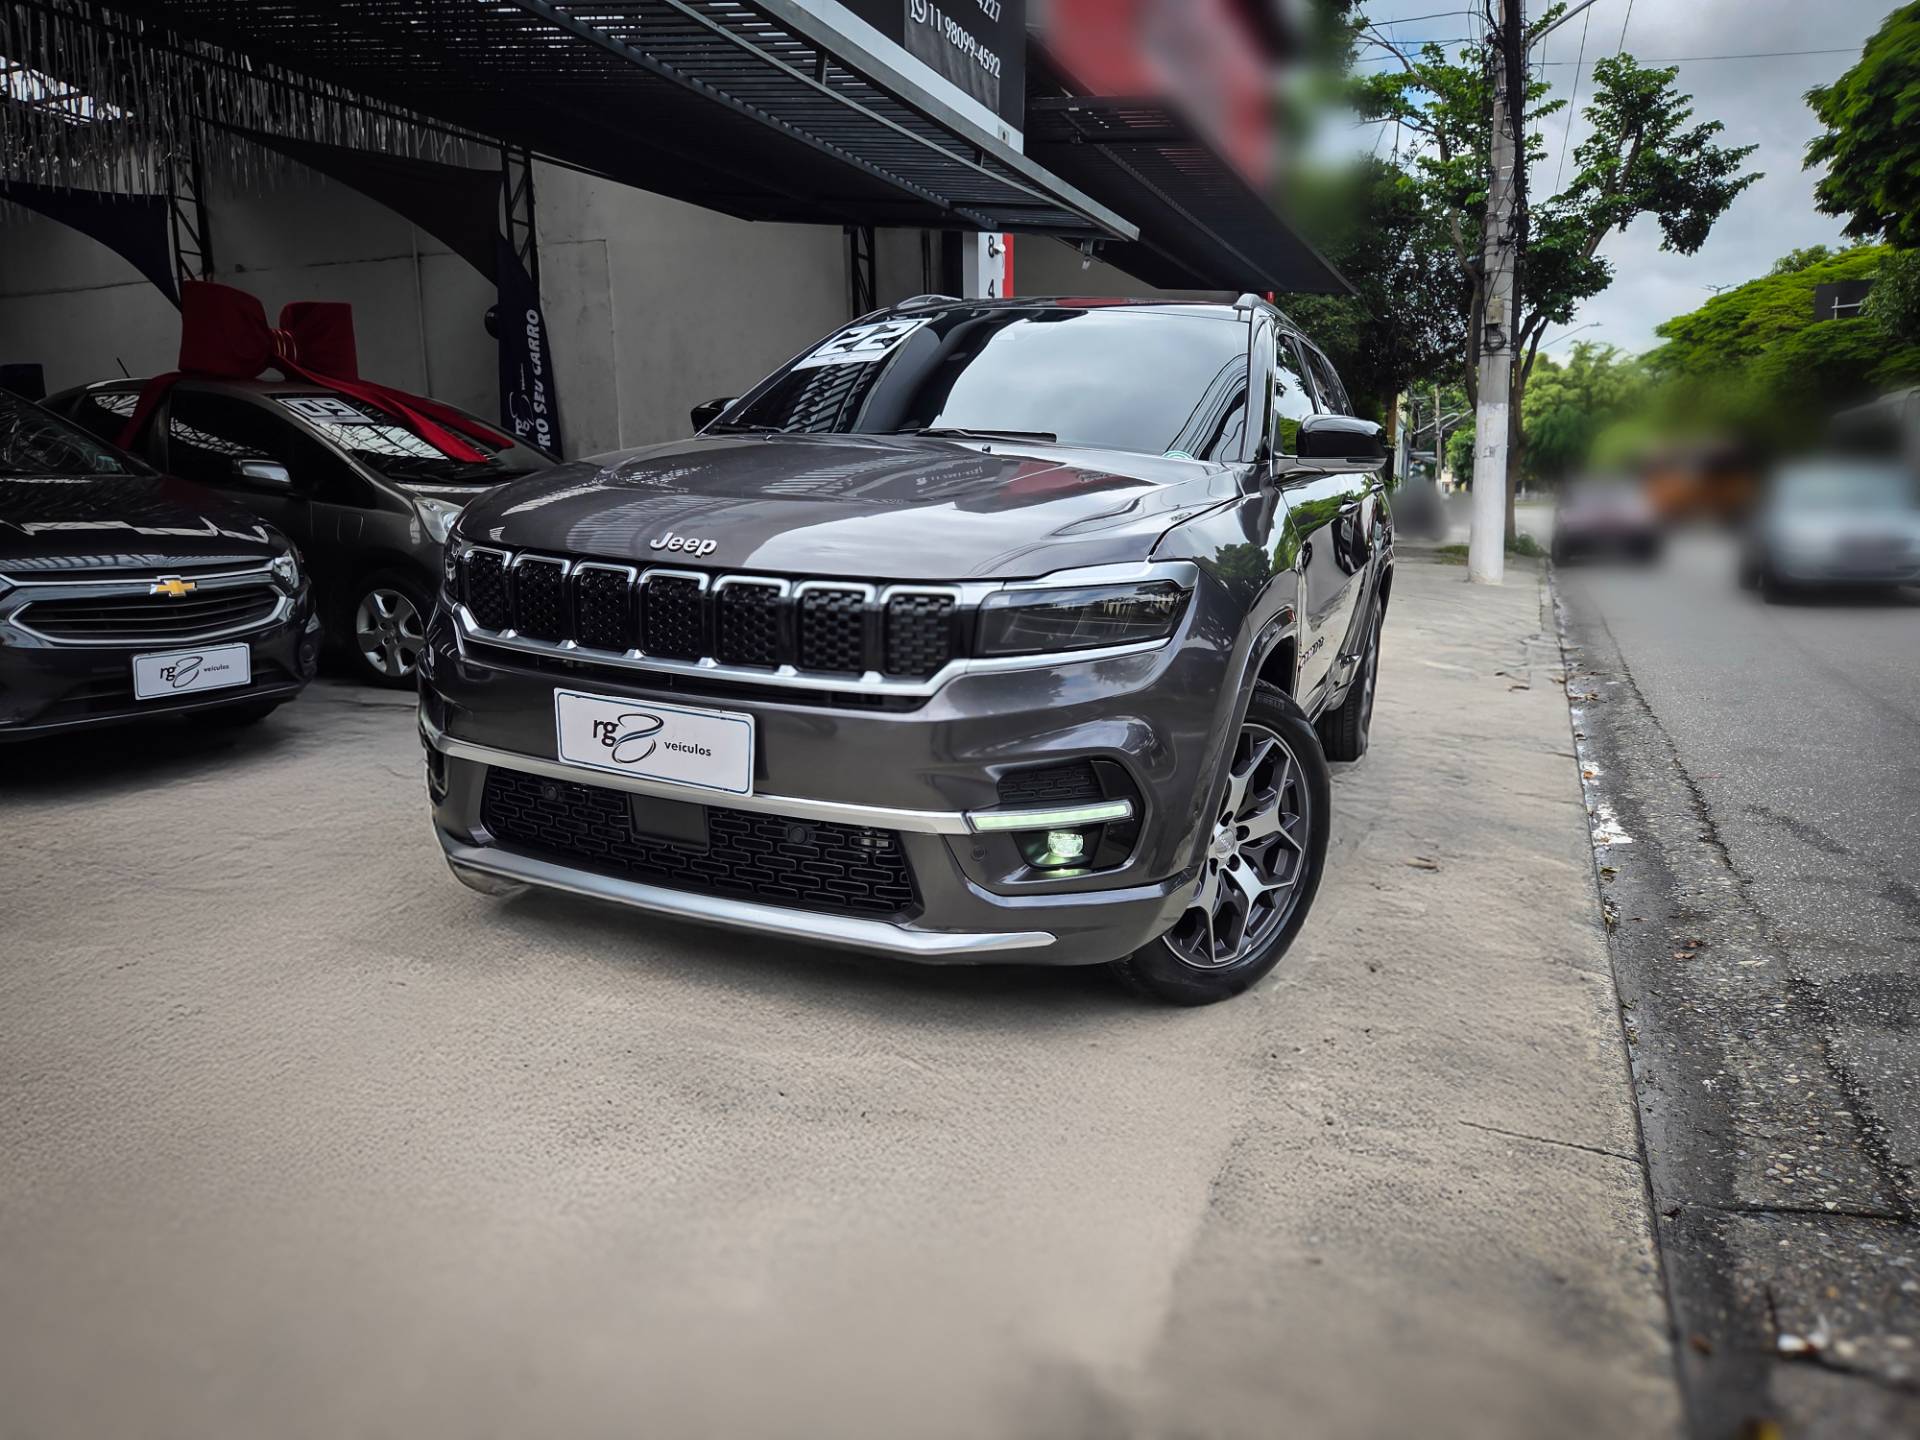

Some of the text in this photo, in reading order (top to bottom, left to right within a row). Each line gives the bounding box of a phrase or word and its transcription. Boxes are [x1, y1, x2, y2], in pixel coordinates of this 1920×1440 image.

[929, 3, 1001, 78] 11 98099-4592
[526, 309, 551, 451] RO SEU CARRO
[650, 531, 718, 556] Jeep
[664, 740, 712, 757] veículos
